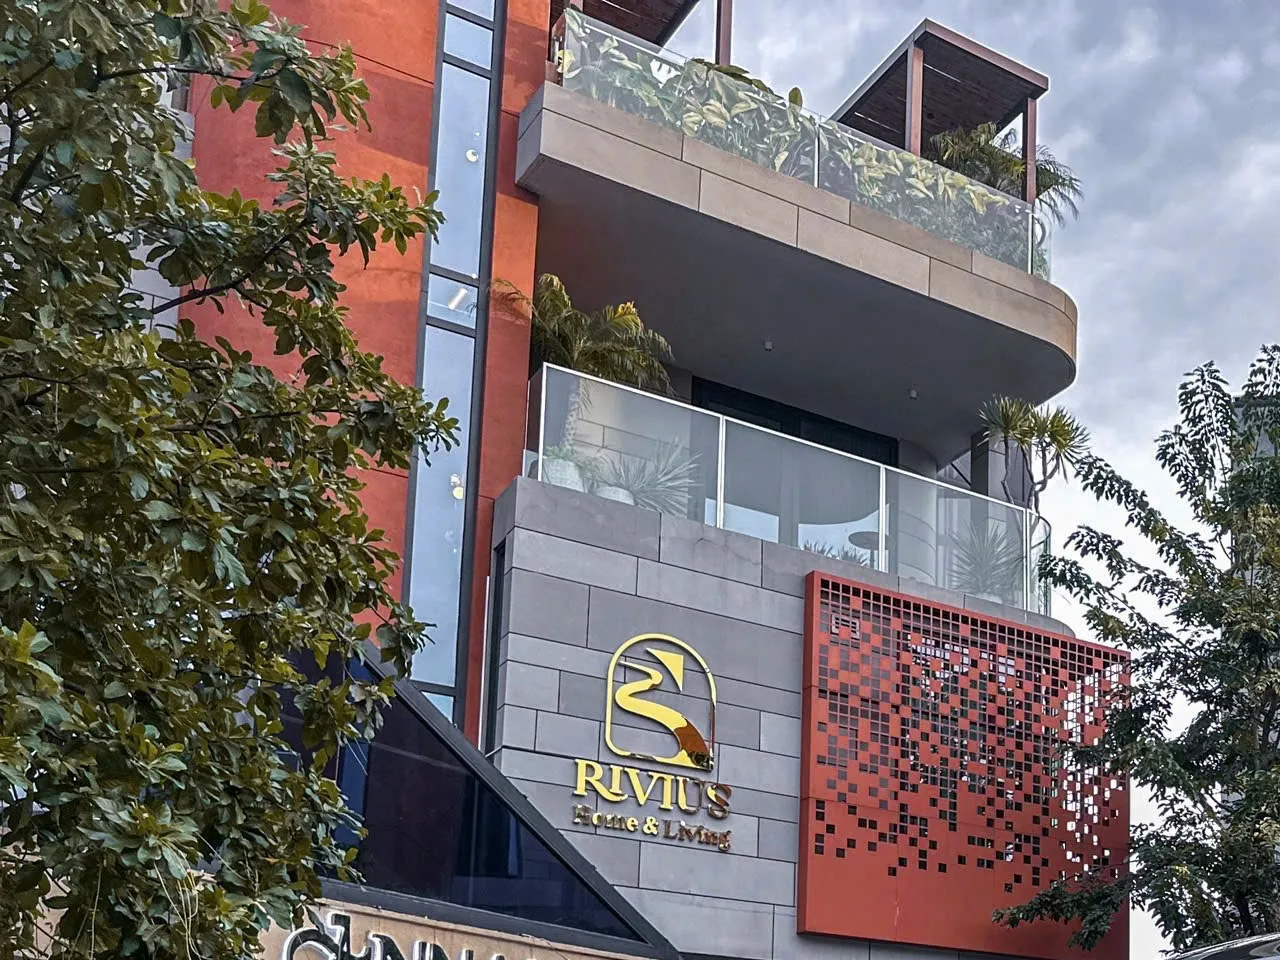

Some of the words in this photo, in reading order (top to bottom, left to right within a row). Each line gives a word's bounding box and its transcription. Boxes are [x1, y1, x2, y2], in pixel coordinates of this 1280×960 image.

[572, 758, 733, 821] RIVIUS
[571, 803, 640, 832] Home
[642, 815, 660, 836] &
[661, 818, 733, 852] Living
